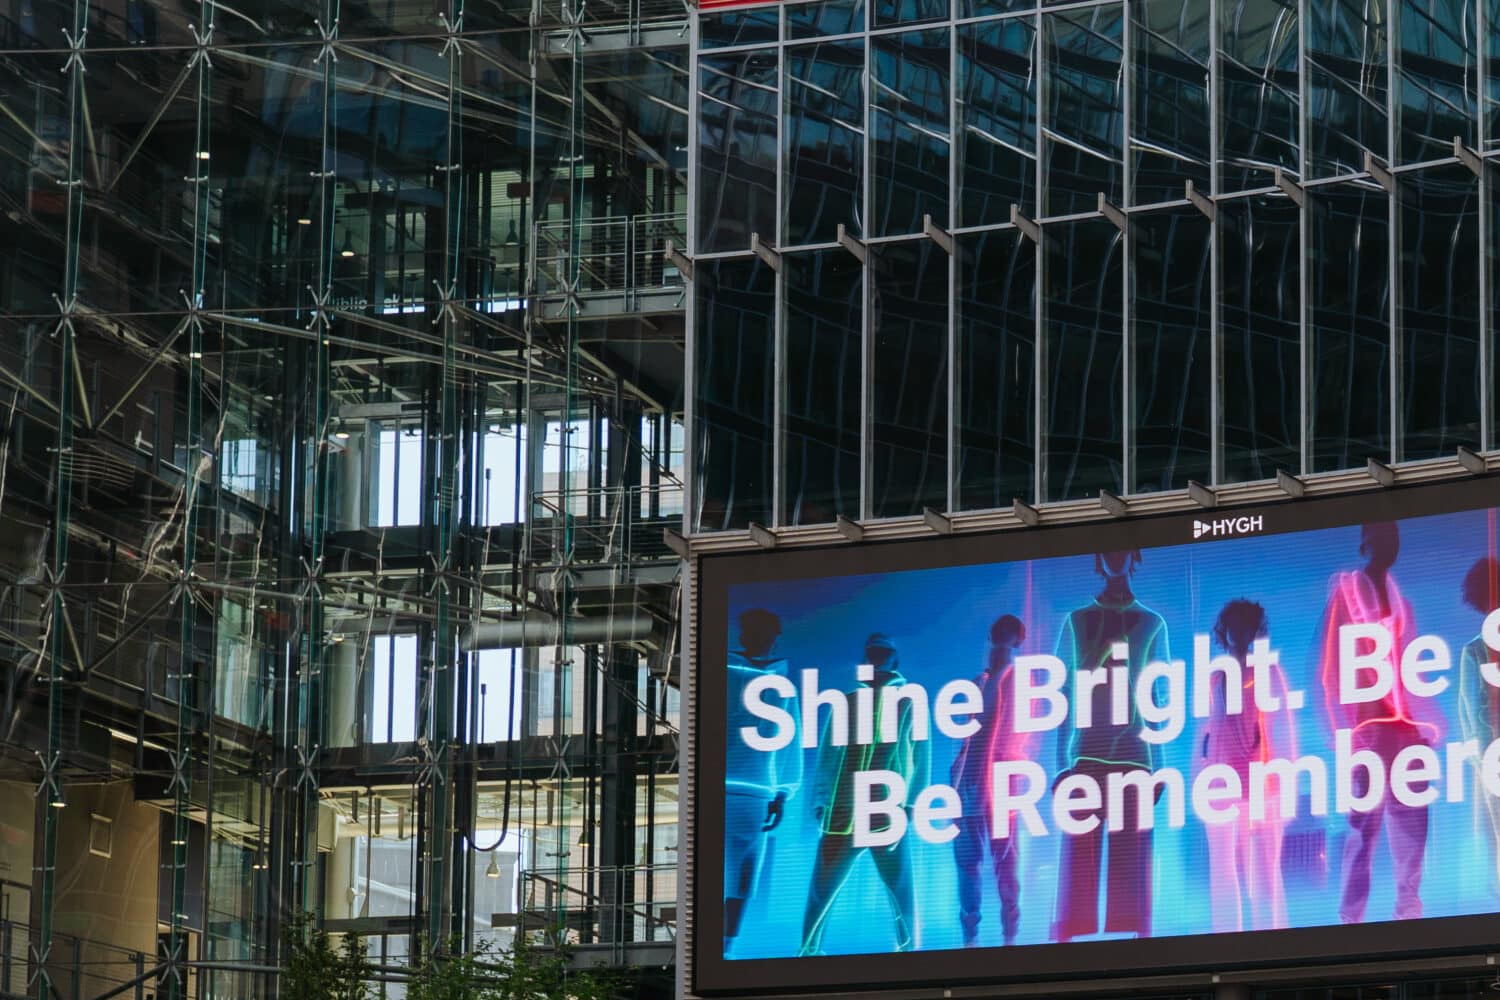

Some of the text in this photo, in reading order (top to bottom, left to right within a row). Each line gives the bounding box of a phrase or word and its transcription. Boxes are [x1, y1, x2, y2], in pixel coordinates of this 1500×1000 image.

[1212, 515, 1262, 535] HYGH
[740, 663, 984, 751] Shine
[1013, 635, 1304, 744] Bright.
[1338, 622, 1451, 705] Be
[853, 769, 962, 848] Be
